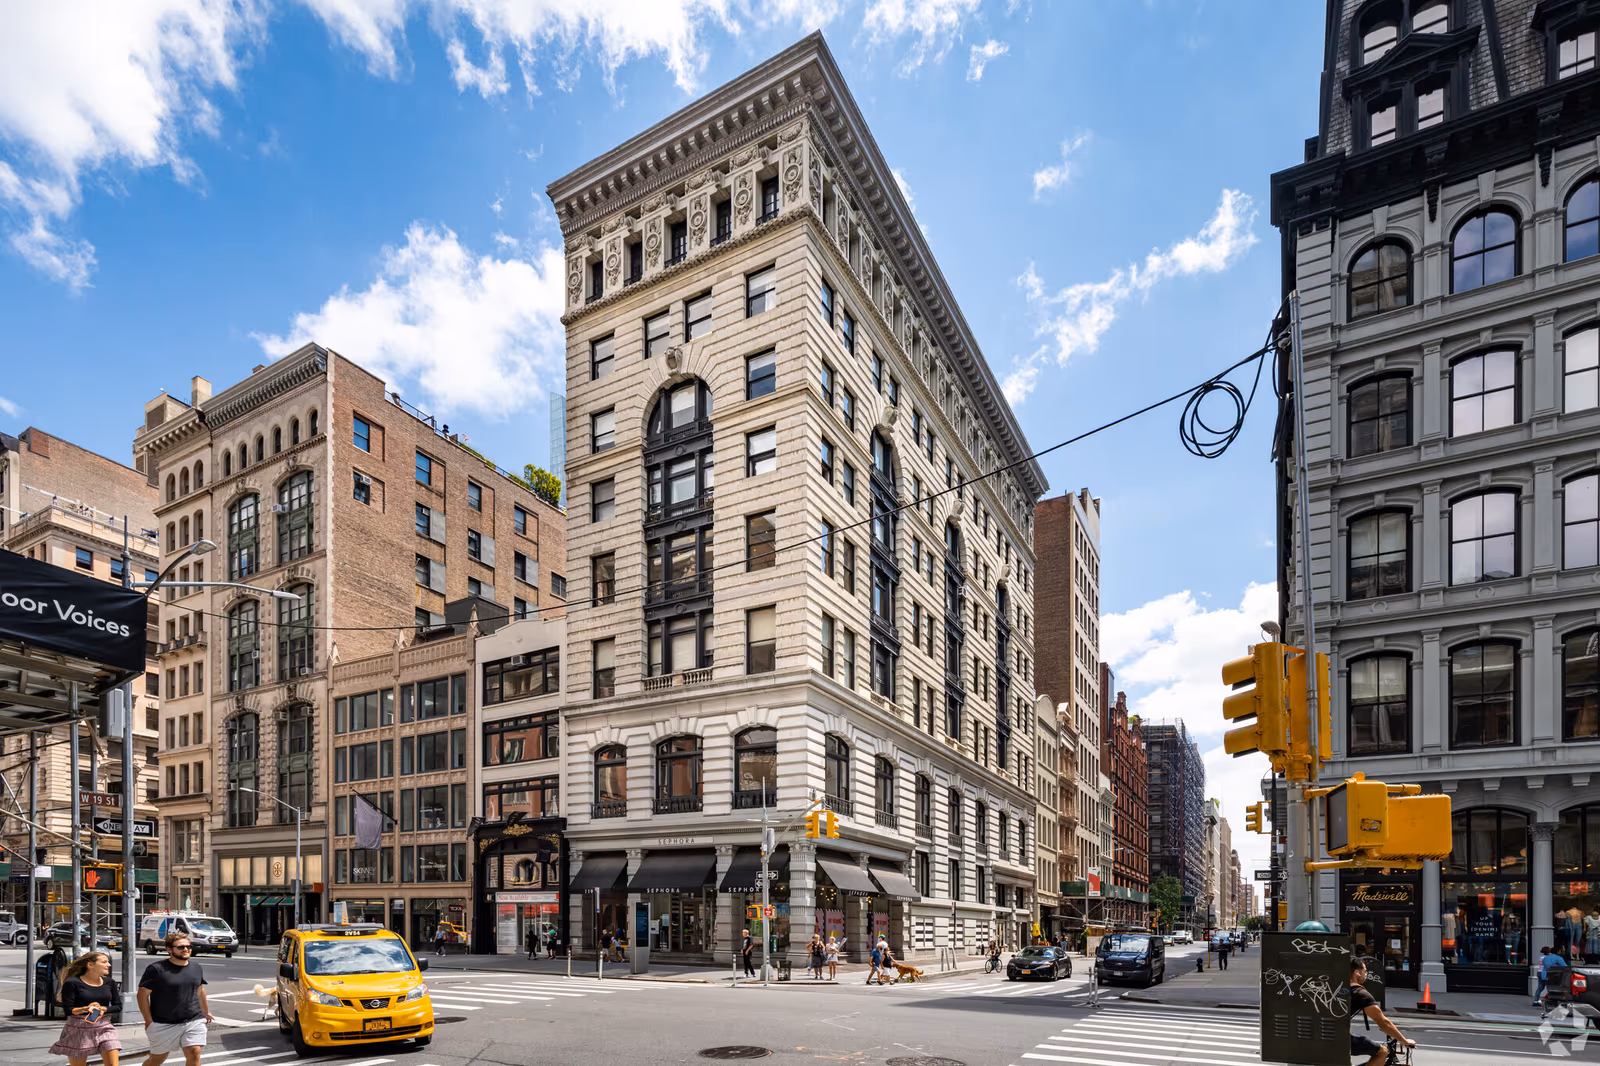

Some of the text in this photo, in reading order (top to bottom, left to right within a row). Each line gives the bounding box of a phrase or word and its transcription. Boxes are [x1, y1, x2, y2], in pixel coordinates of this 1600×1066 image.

[53, 599, 130, 637] Voices
[81, 794, 115, 806] W 19 St
[102, 822, 120, 830] ONE
[658, 837, 695, 845] SEPHORA
[1352, 891, 1409, 903] Madewell
